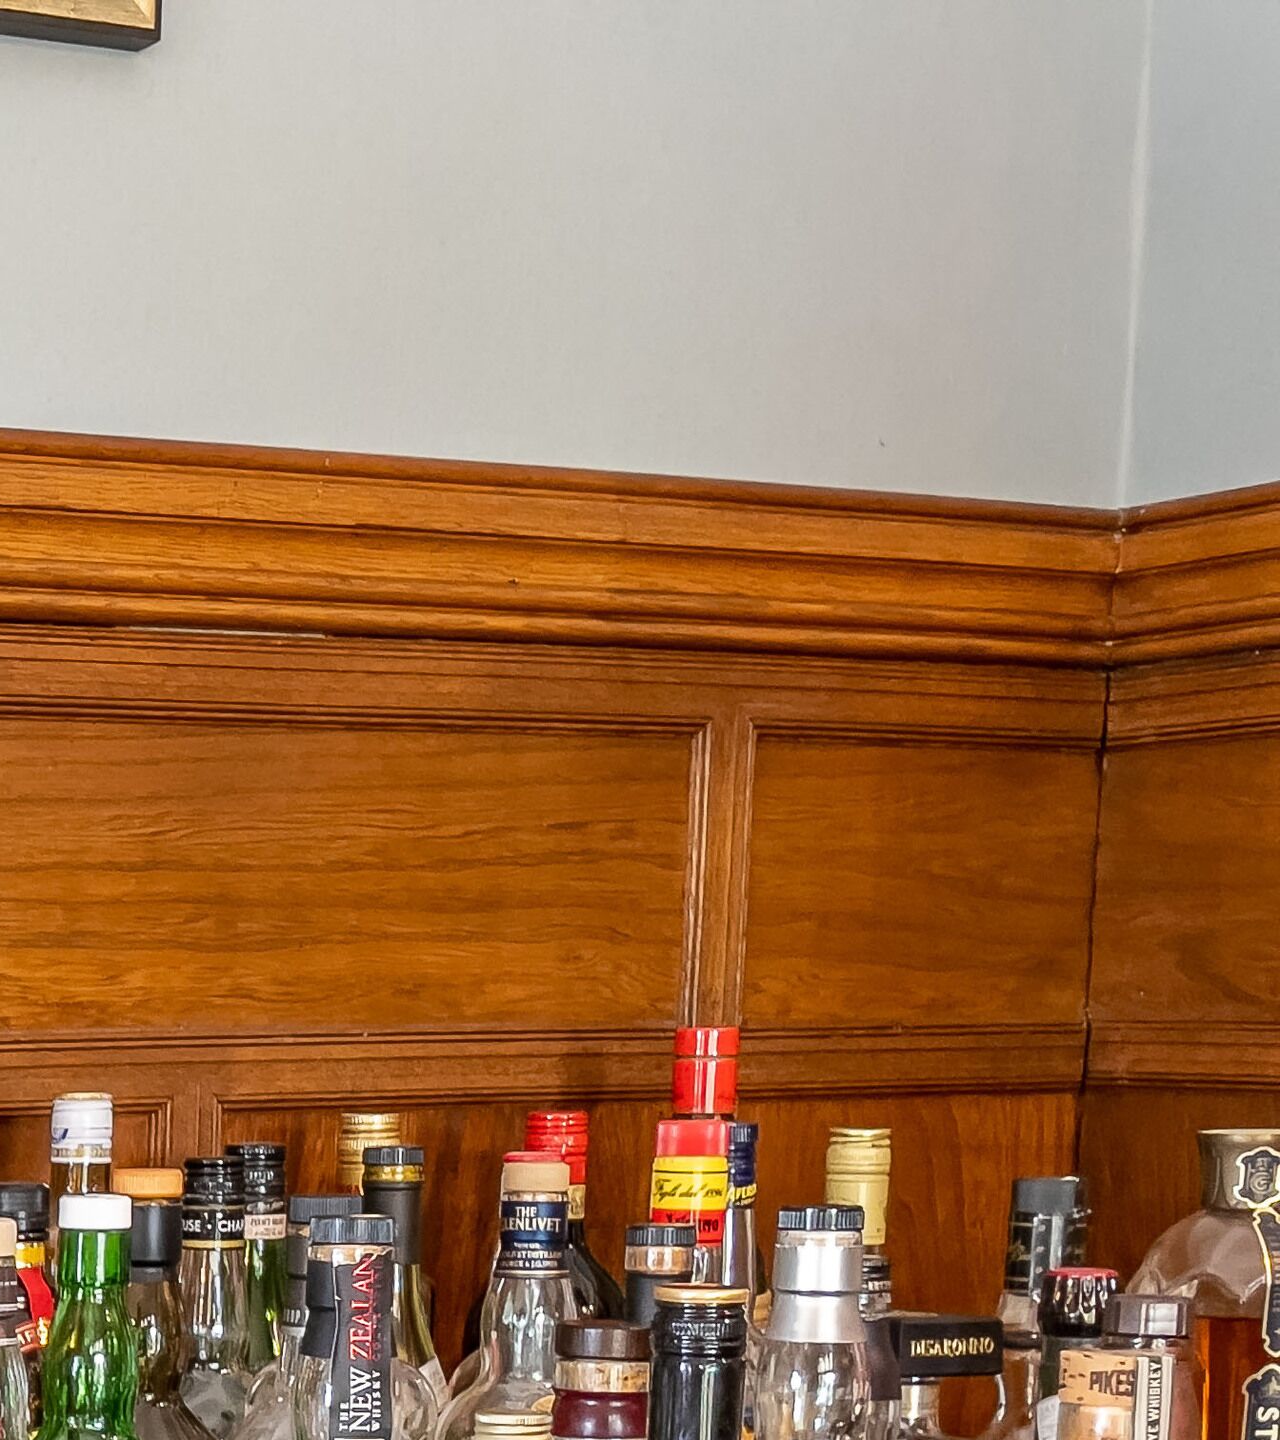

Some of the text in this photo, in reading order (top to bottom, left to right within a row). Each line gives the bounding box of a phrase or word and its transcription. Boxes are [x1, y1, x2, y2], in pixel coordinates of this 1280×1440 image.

[515, 1206, 536, 1217] THE
[349, 1253, 375, 1432] NEW ZEALAN
[910, 1337, 994, 1358] DISARONNO
[1089, 1370, 1136, 1397] PIKES
[1148, 1362, 1162, 1423] WHISKEY
[371, 1371, 381, 1432] WHISKY
[339, 1403, 349, 1431] THE
